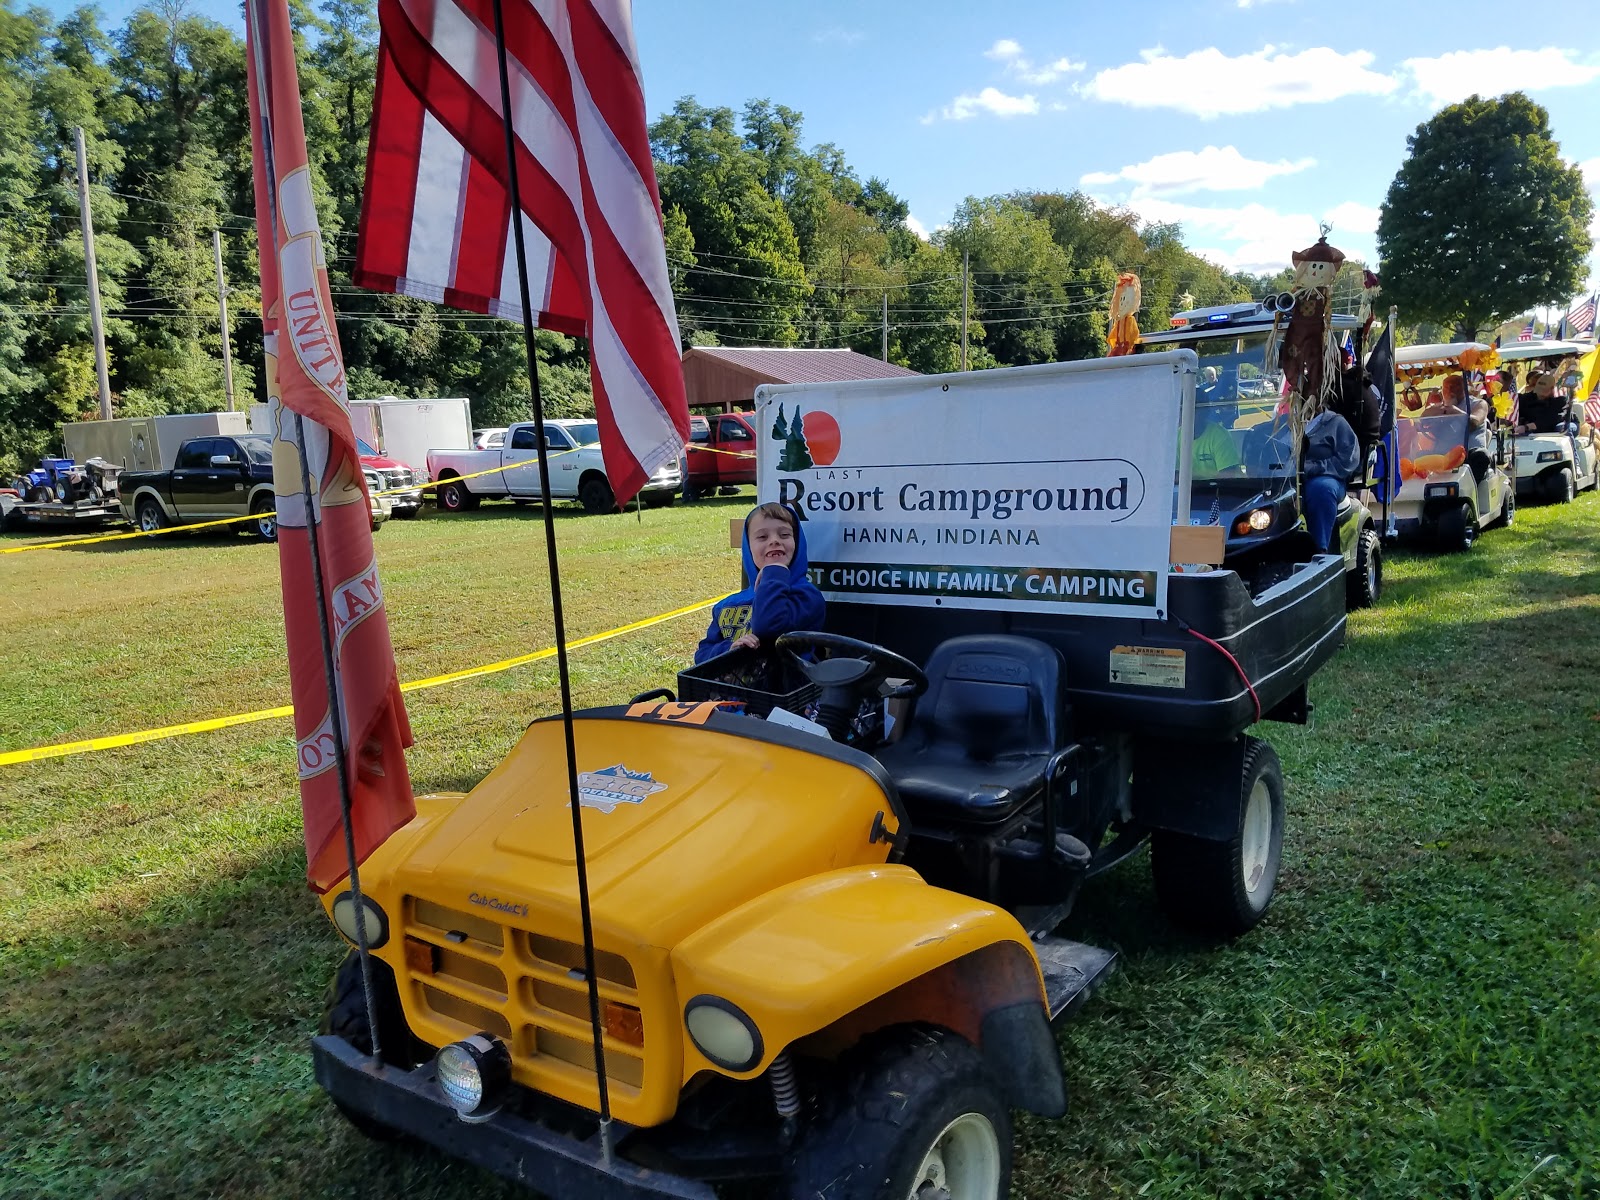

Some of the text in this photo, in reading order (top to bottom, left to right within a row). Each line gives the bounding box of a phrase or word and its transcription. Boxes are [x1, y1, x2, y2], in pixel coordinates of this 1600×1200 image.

[288, 287, 350, 408] UNITE
[815, 469, 864, 480] LAST
[778, 477, 1129, 521] Resort Campground
[843, 527, 1041, 546] HANNA, INDIANA
[806, 568, 1146, 599] ST CHOICE IN FAMILY CAMPING
[579, 786, 645, 803] OUNTRY
[582, 773, 652, 796] BIG
[468, 892, 488, 907] Cub
